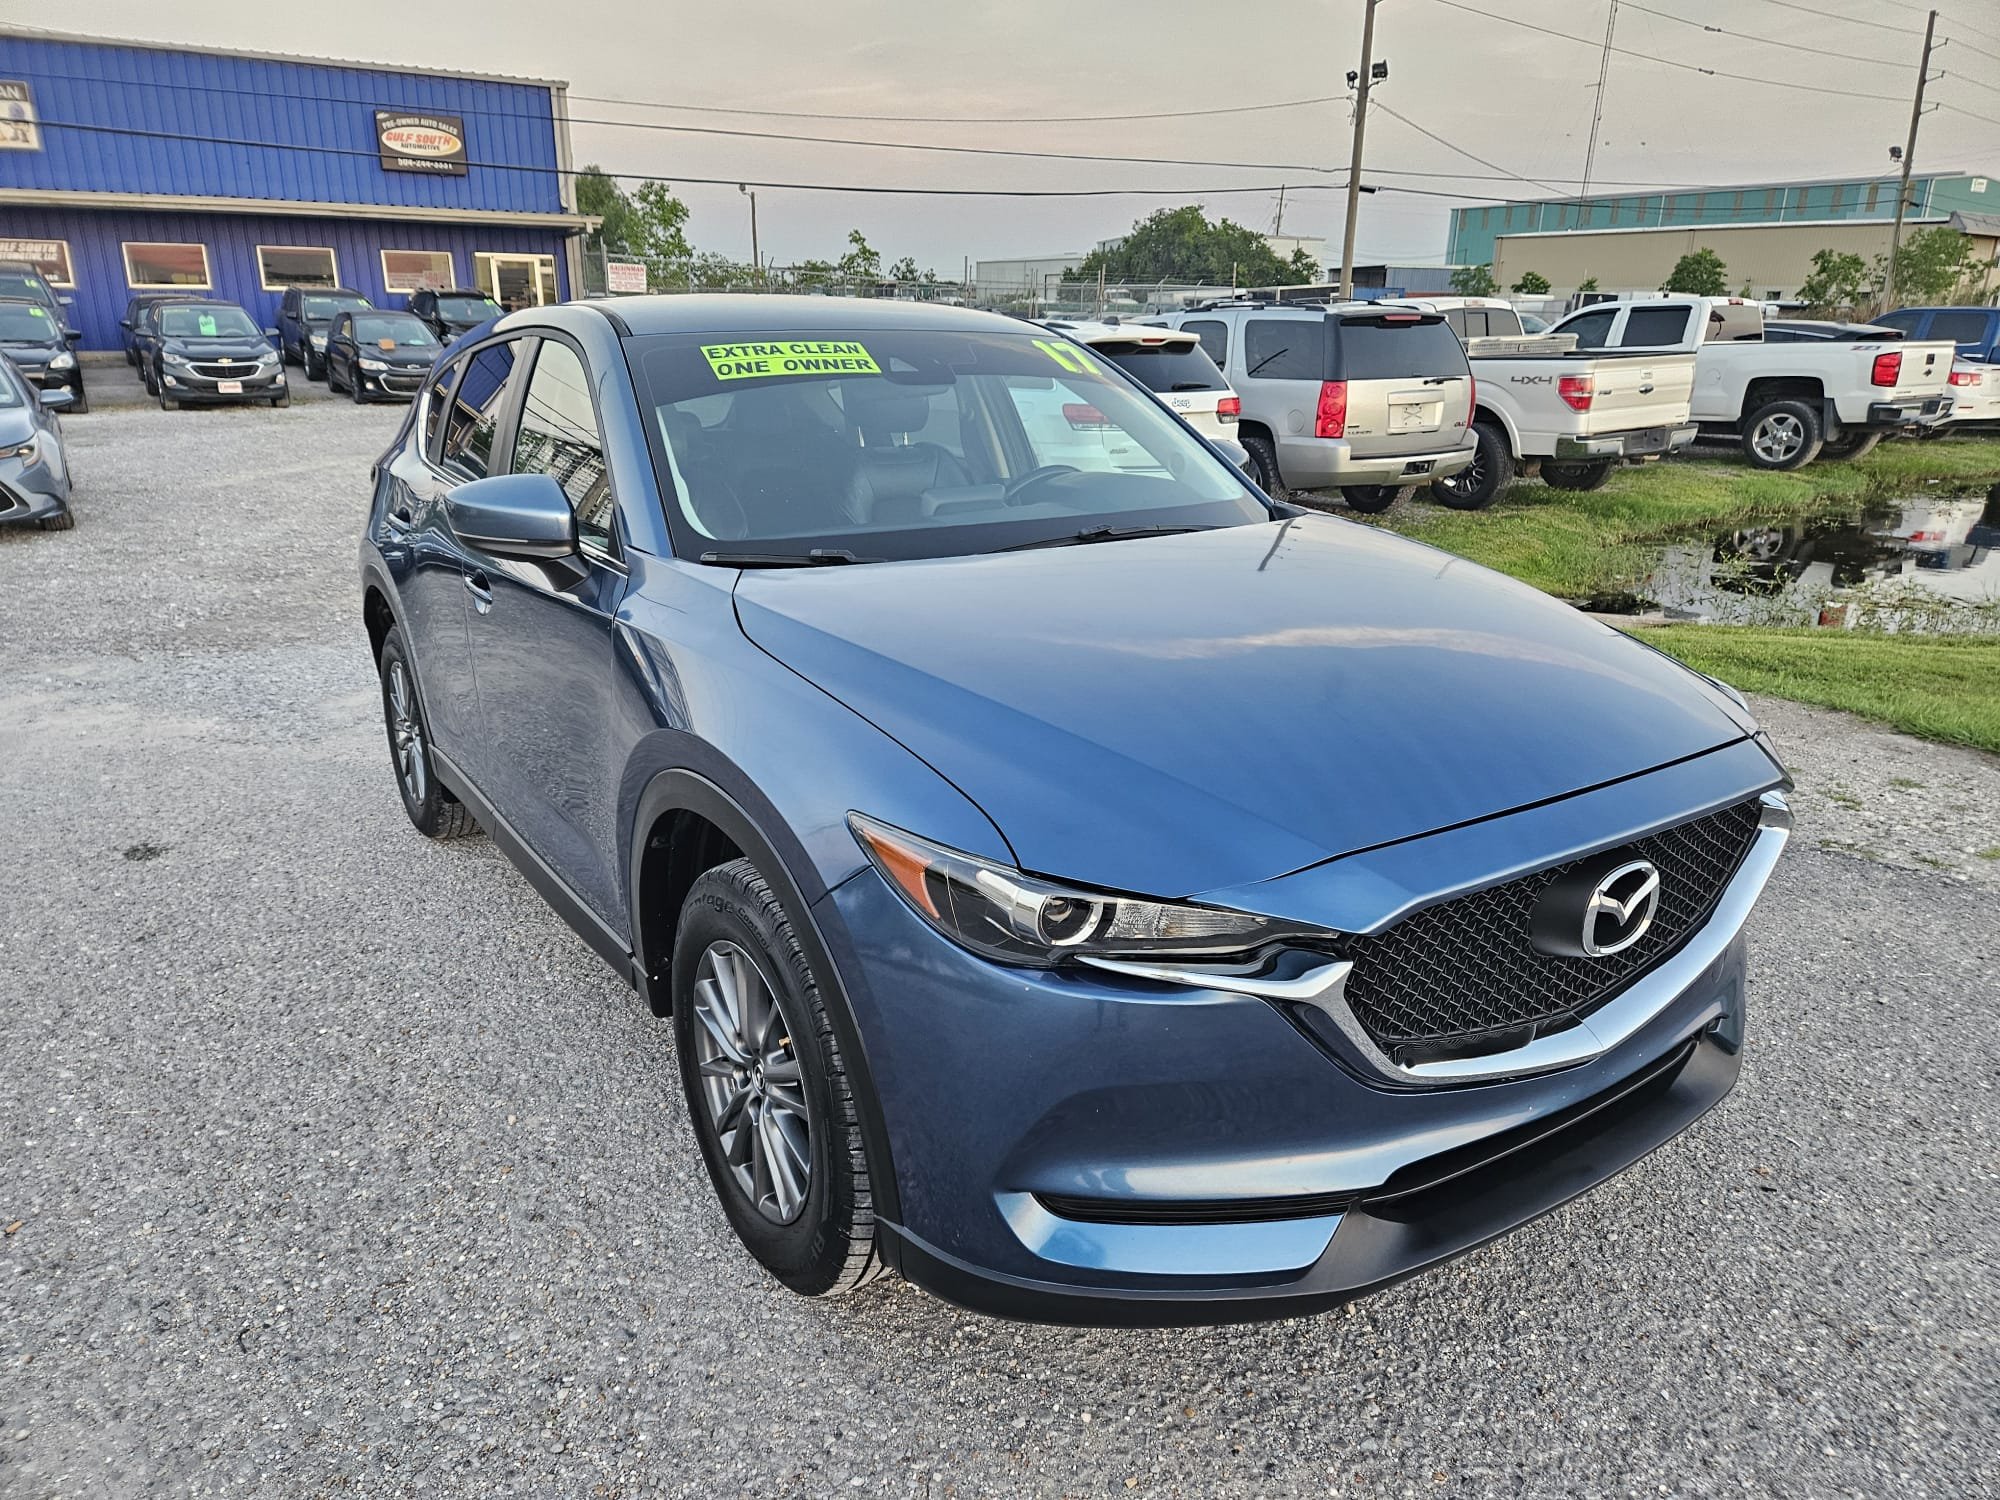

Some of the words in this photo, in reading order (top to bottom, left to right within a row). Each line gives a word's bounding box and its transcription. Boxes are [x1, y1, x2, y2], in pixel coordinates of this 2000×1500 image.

[382, 117, 420, 130] PRE-OWNED
[420, 118, 438, 127] AUTO
[438, 122, 458, 135] SALES
[385, 132, 413, 143] GULF
[415, 134, 452, 146] SOUTH
[400, 143, 440, 151] AUTOMOTIVE
[18, 243, 57, 253] SOUTH
[706, 344, 785, 359] EXTRA
[789, 343, 861, 355] CLEAN
[1031, 339, 1102, 376] 17
[717, 360, 771, 376] ONE
[783, 358, 873, 371] OWNER
[1172, 397, 1192, 409] Jeep
